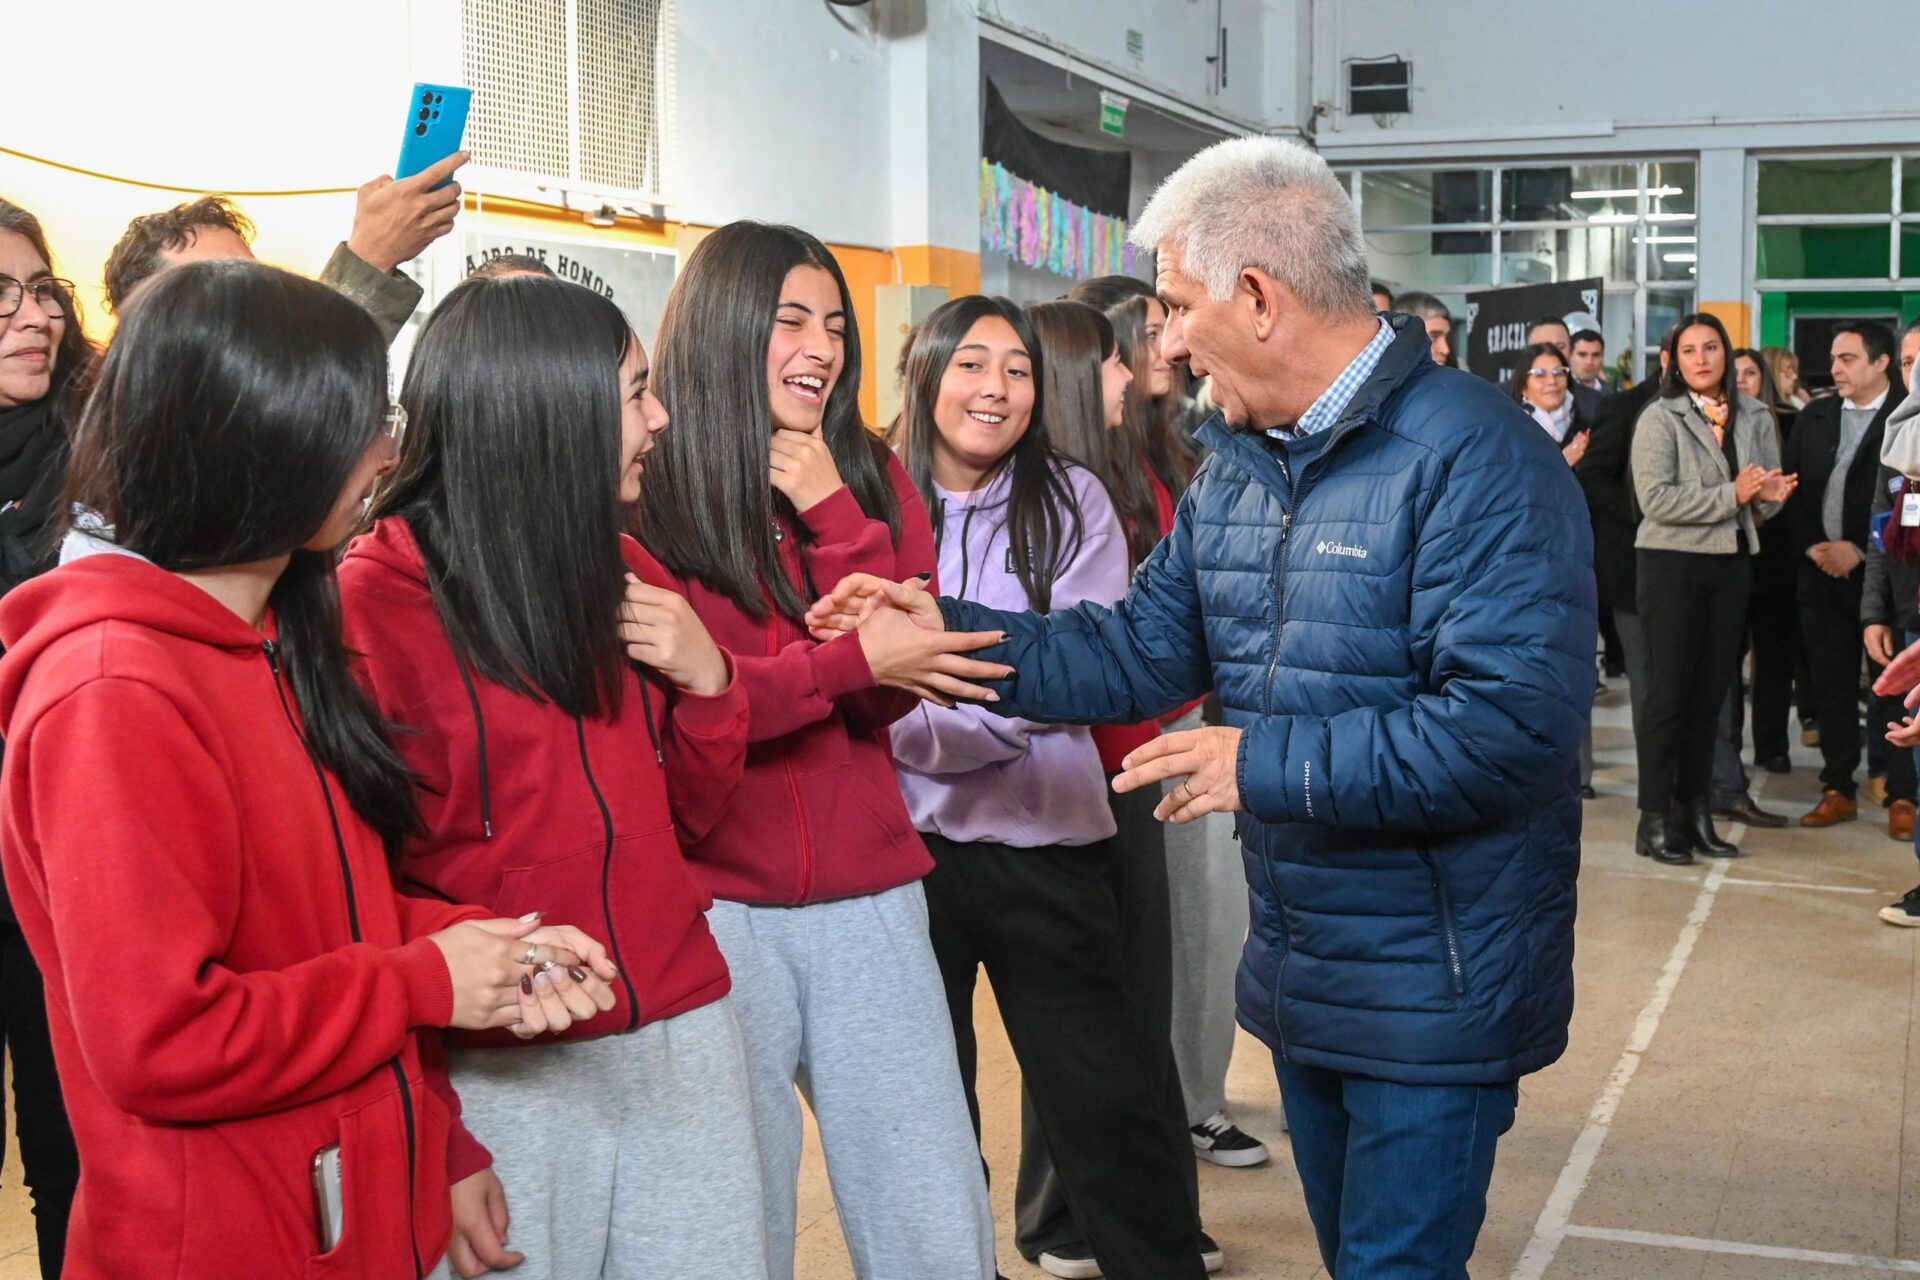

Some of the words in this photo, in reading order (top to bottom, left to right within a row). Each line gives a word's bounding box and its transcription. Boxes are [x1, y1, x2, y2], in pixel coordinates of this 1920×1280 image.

[557, 254, 614, 300] HONOR
[1487, 321, 1531, 354] GRACIA
[1326, 541, 1368, 559] Columbia
